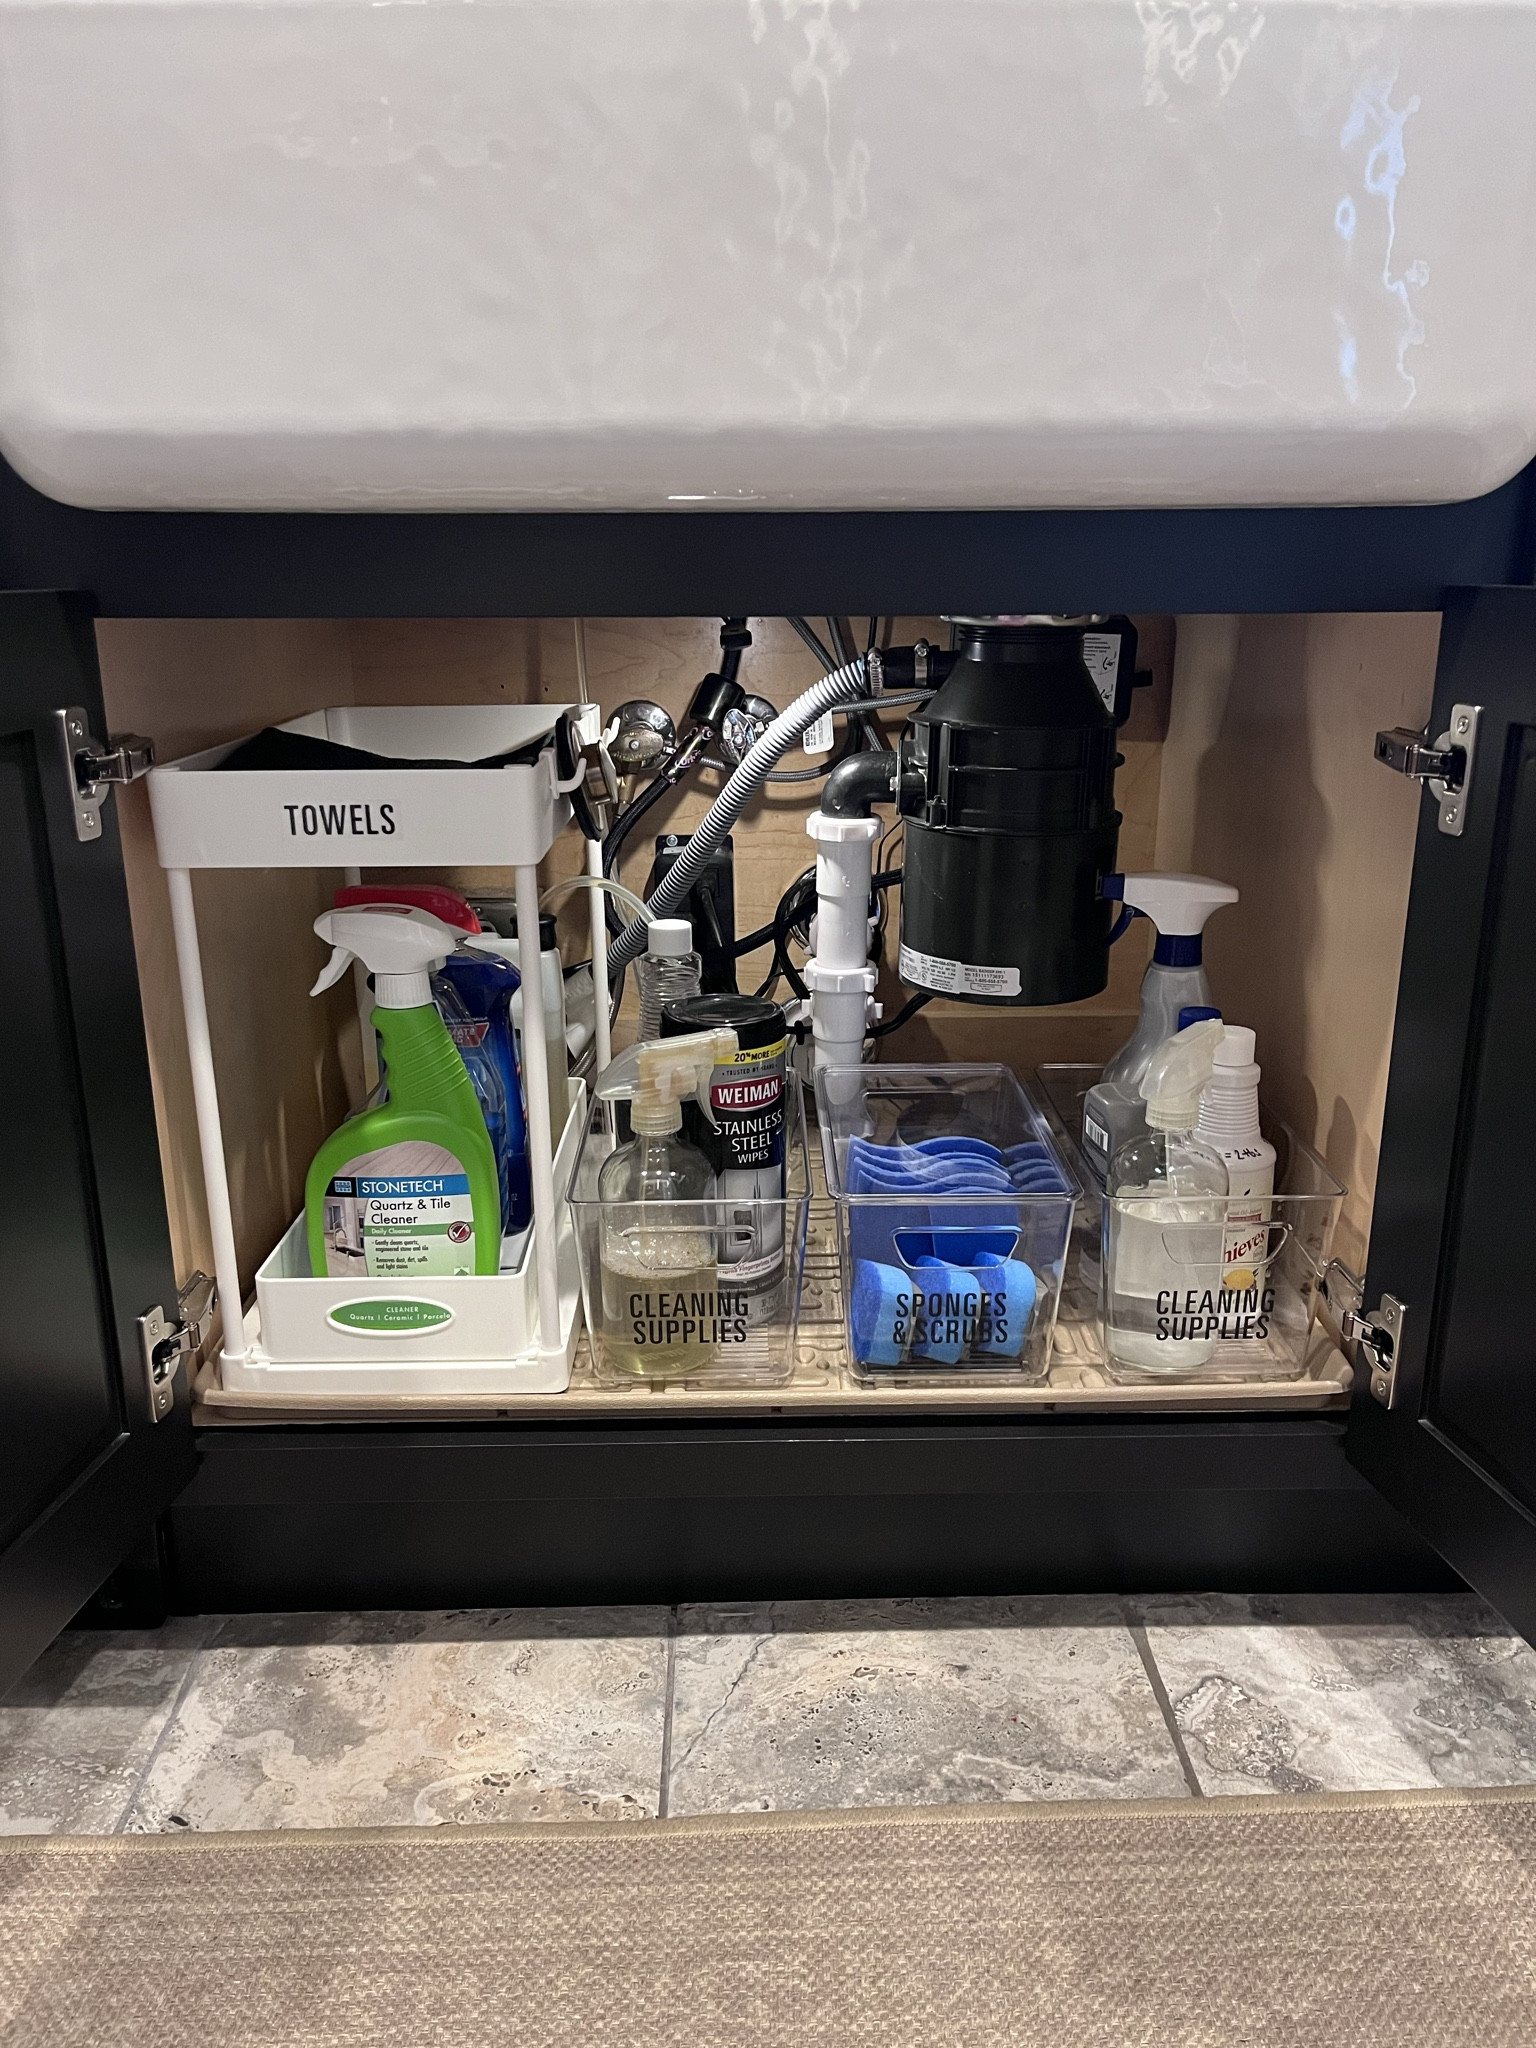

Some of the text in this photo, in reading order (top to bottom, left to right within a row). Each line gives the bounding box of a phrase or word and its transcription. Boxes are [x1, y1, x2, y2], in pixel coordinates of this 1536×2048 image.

[284, 804, 395, 835] TOWELS
[751, 1050, 770, 1060] MORE
[726, 1068, 750, 1076] TRUSTED
[718, 1079, 779, 1104] WEIMAN
[714, 1109, 782, 1135] STAINLESS
[732, 1132, 772, 1152] STEEL
[738, 1149, 769, 1164] WIPES
[361, 1180, 444, 1194] STONETECH
[370, 1197, 451, 1210] Quartz & Tile
[371, 1213, 418, 1224] Cleaner
[372, 1228, 387, 1236] Daily
[630, 1292, 748, 1318] CLEANING
[896, 1293, 1006, 1317] SPONGES
[1156, 1289, 1275, 1314] CLEANING
[633, 1319, 747, 1345] SUPPLIES
[893, 1319, 1008, 1344] & SCRUBS
[1156, 1315, 1270, 1340] SUPPLIES
